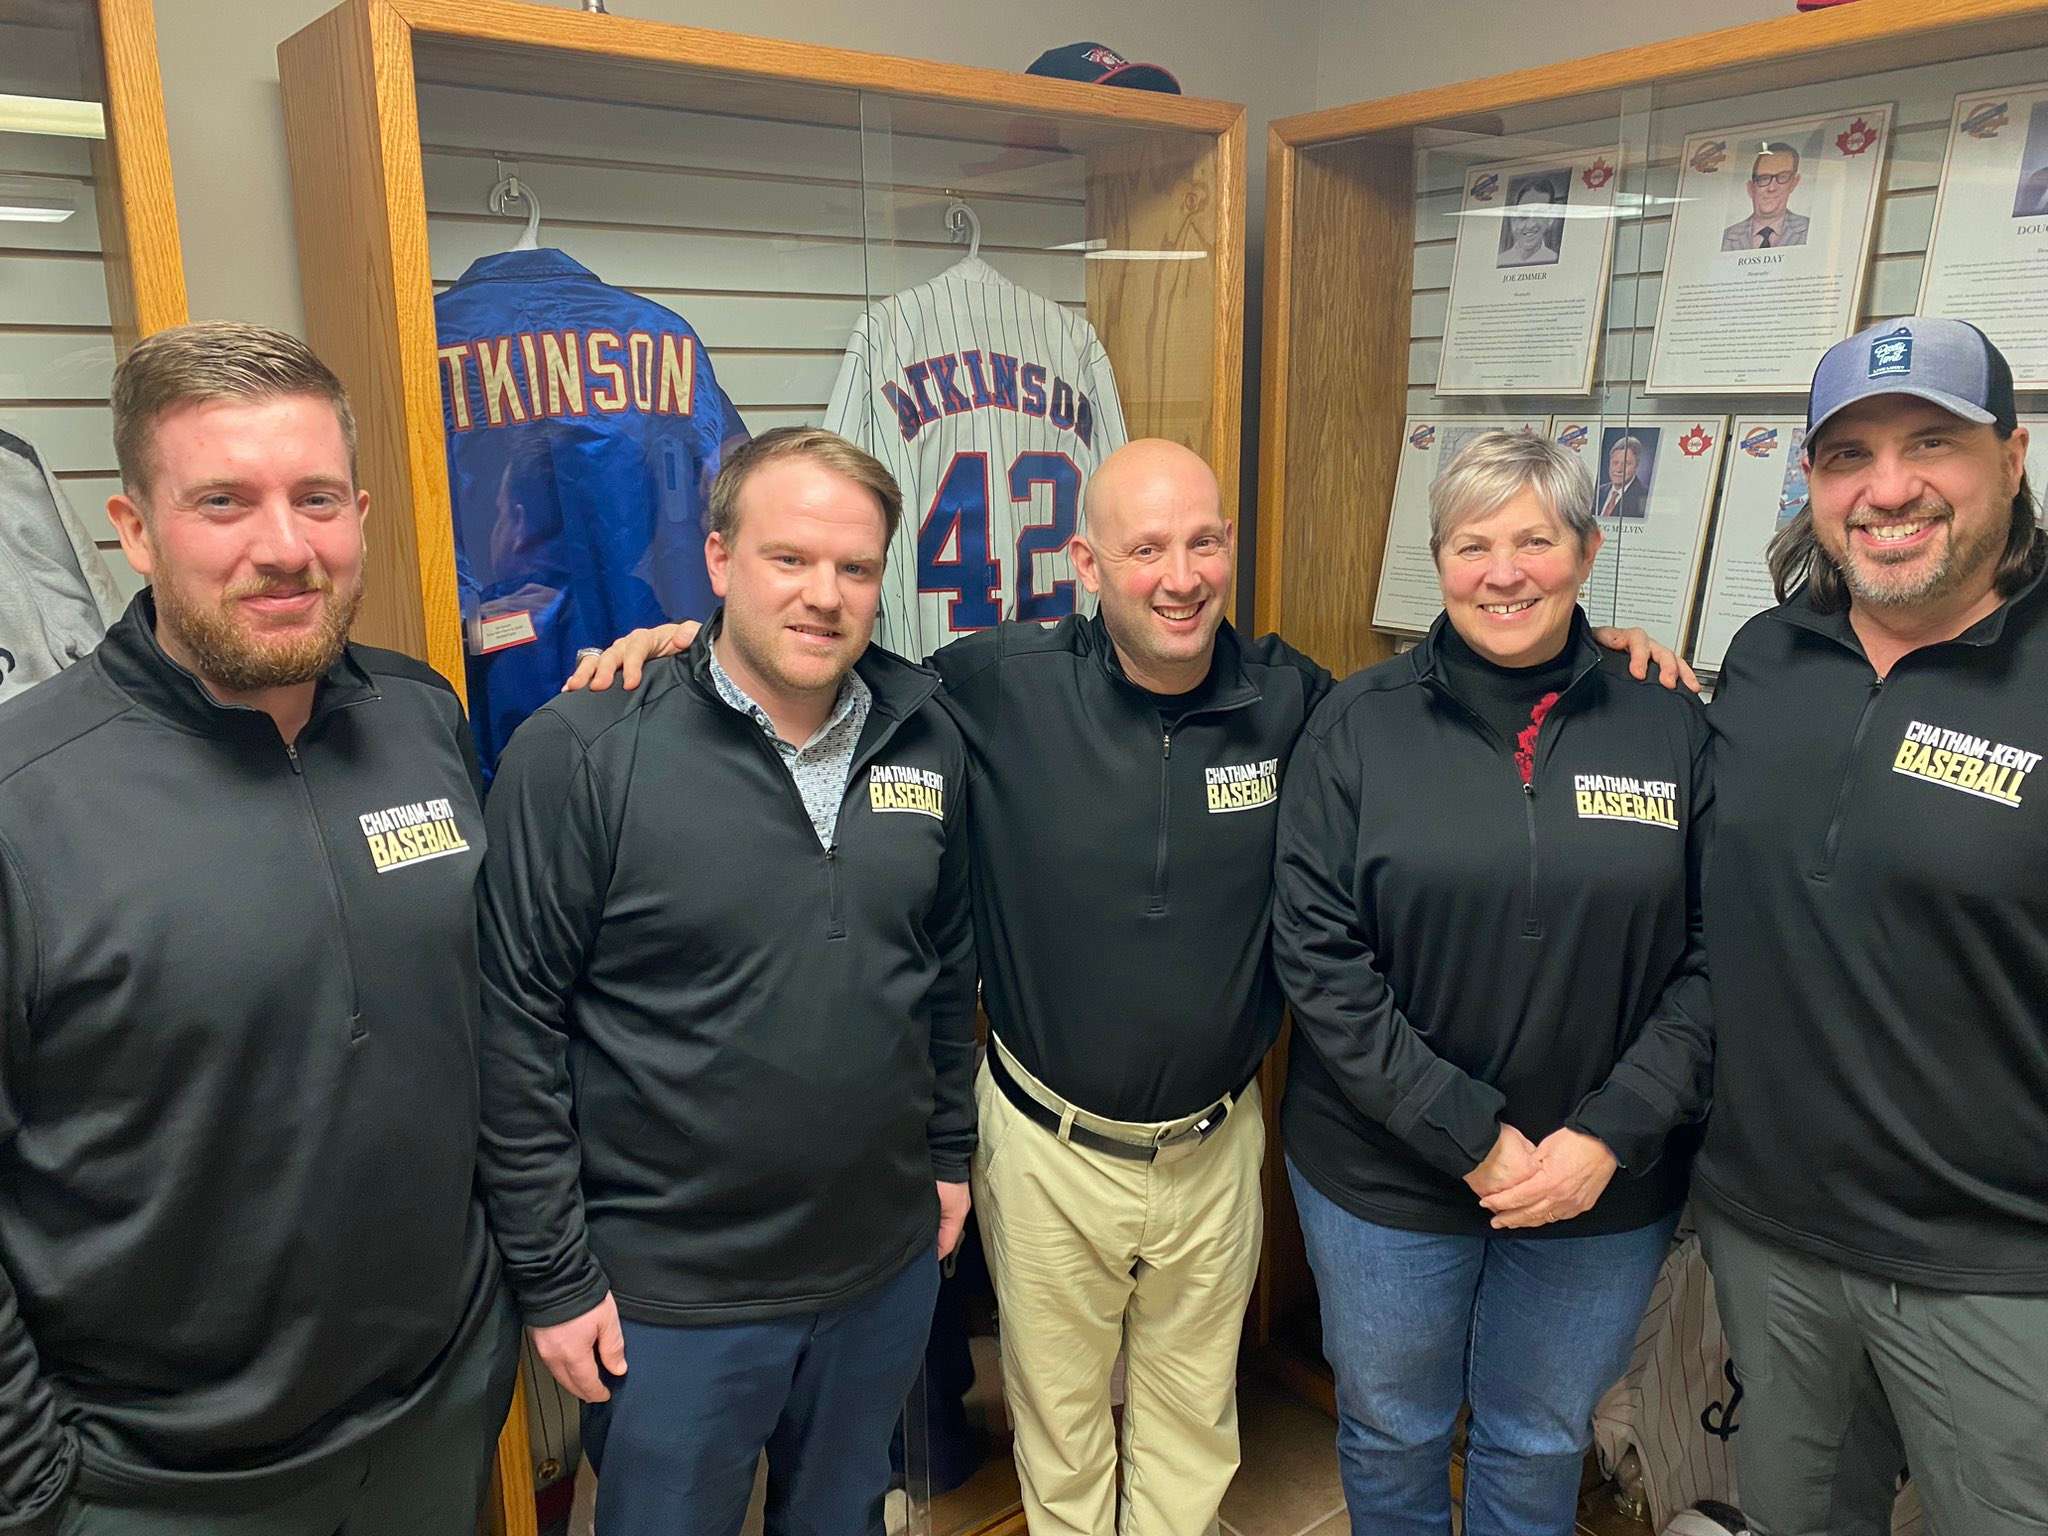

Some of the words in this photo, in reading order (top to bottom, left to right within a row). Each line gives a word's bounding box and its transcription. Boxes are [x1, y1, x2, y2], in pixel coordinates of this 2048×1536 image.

[1502, 273, 1516, 283] JOE
[1517, 271, 1549, 282] ZIMMER
[1737, 256, 1762, 266] ROSS
[1763, 254, 1785, 265] DAY
[438, 327, 695, 432] TKINSON
[918, 451, 1082, 632] 42
[1612, 523, 1645, 534] MELVIN
[1904, 720, 2043, 774] CHATHAM-KENT
[870, 765, 944, 791] CHATHAM-KENT
[1205, 757, 1279, 785] CHATHAM-KENT
[1574, 774, 1677, 800] CHATHAM-KENT
[1893, 739, 2026, 804] BASEBALL
[869, 782, 944, 817] BASEBALL
[1206, 773, 1278, 809] BASEBALL
[1576, 791, 1679, 826] BASEBALL
[358, 798, 455, 837] CHATHAM-KENT
[367, 818, 469, 868] BASEBALL
